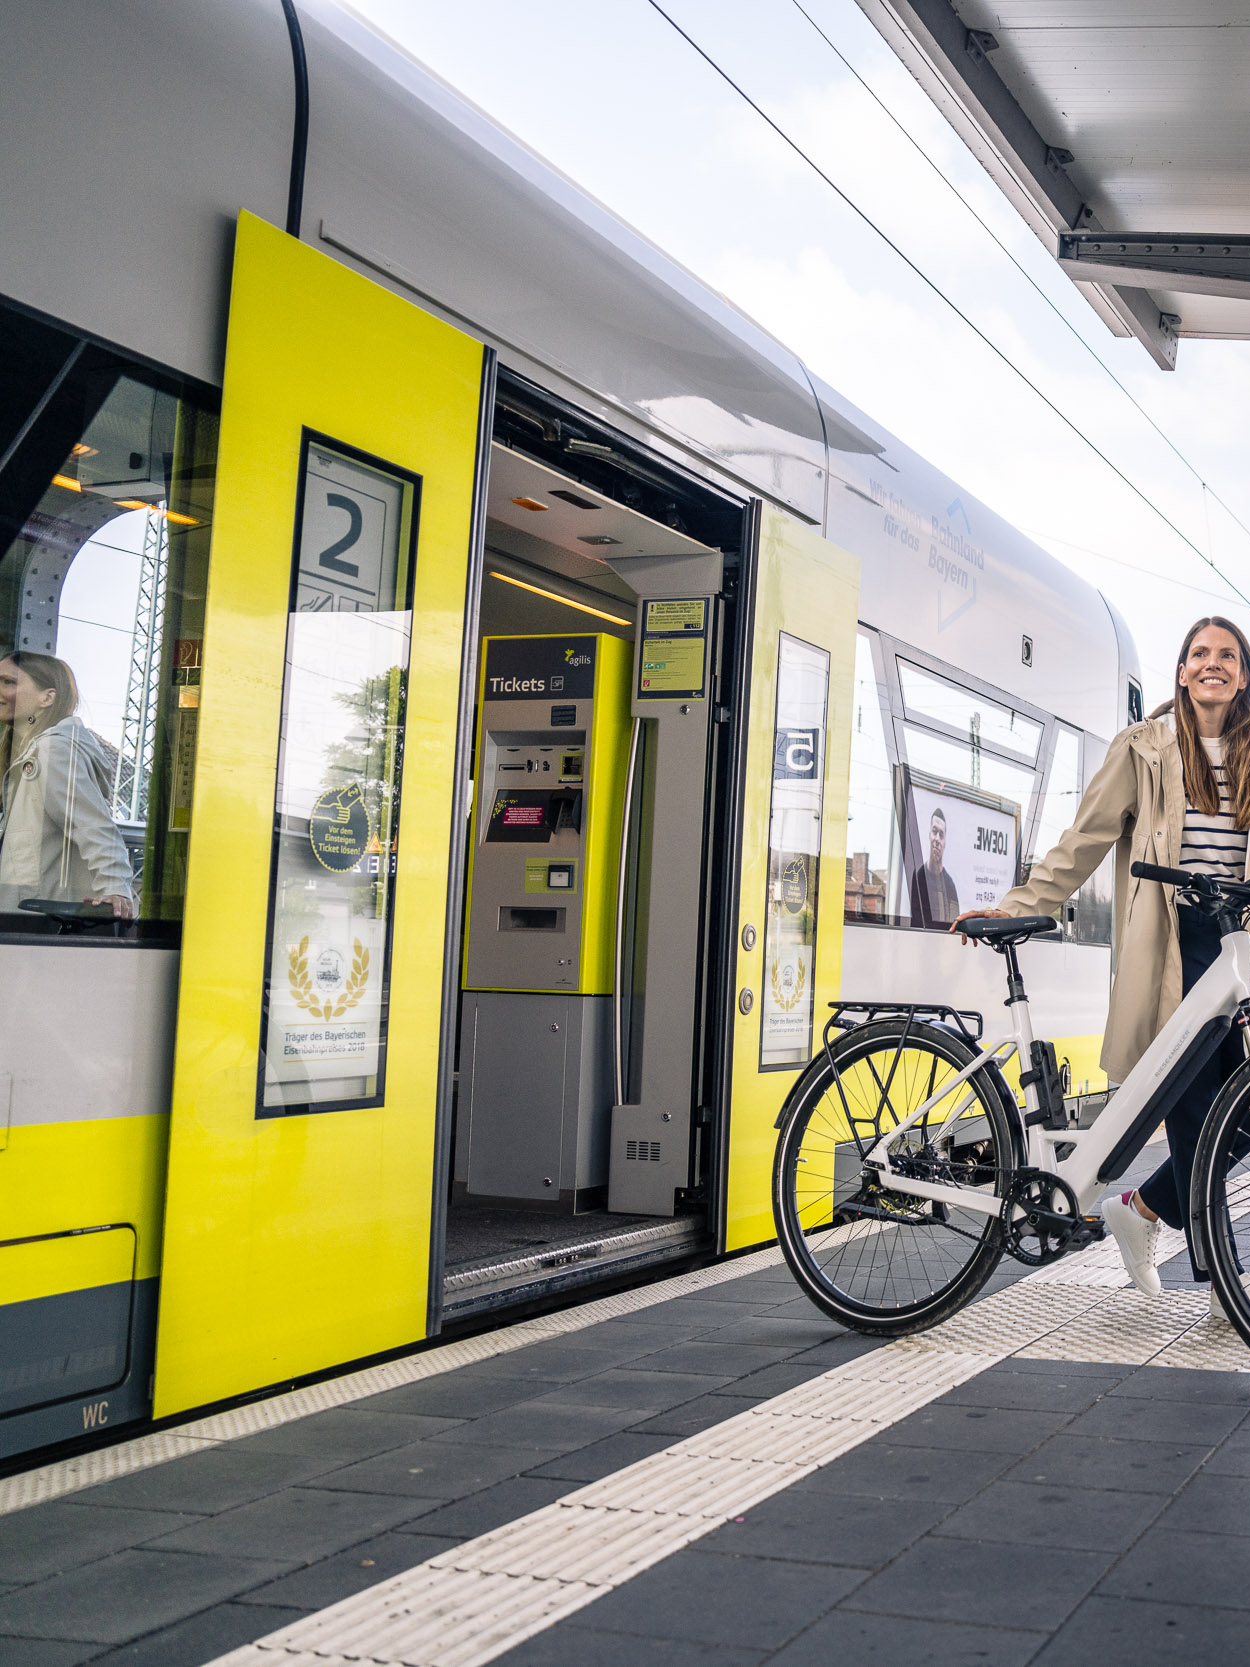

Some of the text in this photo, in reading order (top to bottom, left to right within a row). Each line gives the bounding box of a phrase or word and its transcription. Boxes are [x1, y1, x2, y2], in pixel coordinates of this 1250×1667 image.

[318, 492, 363, 578] 2
[883, 514, 919, 552] für das
[931, 514, 984, 571] Bahnland
[928, 543, 968, 590] Bayern
[569, 655, 591, 666] agilis
[490, 677, 545, 692] Tickets
[340, 827, 353, 835] dem
[325, 834, 356, 845] Einsteigen
[318, 843, 361, 855] Ticket lösen!
[285, 1030, 366, 1043] Träger des Bayerischen
[348, 1042, 365, 1052] 2018
[83, 1401, 109, 1429] WC
